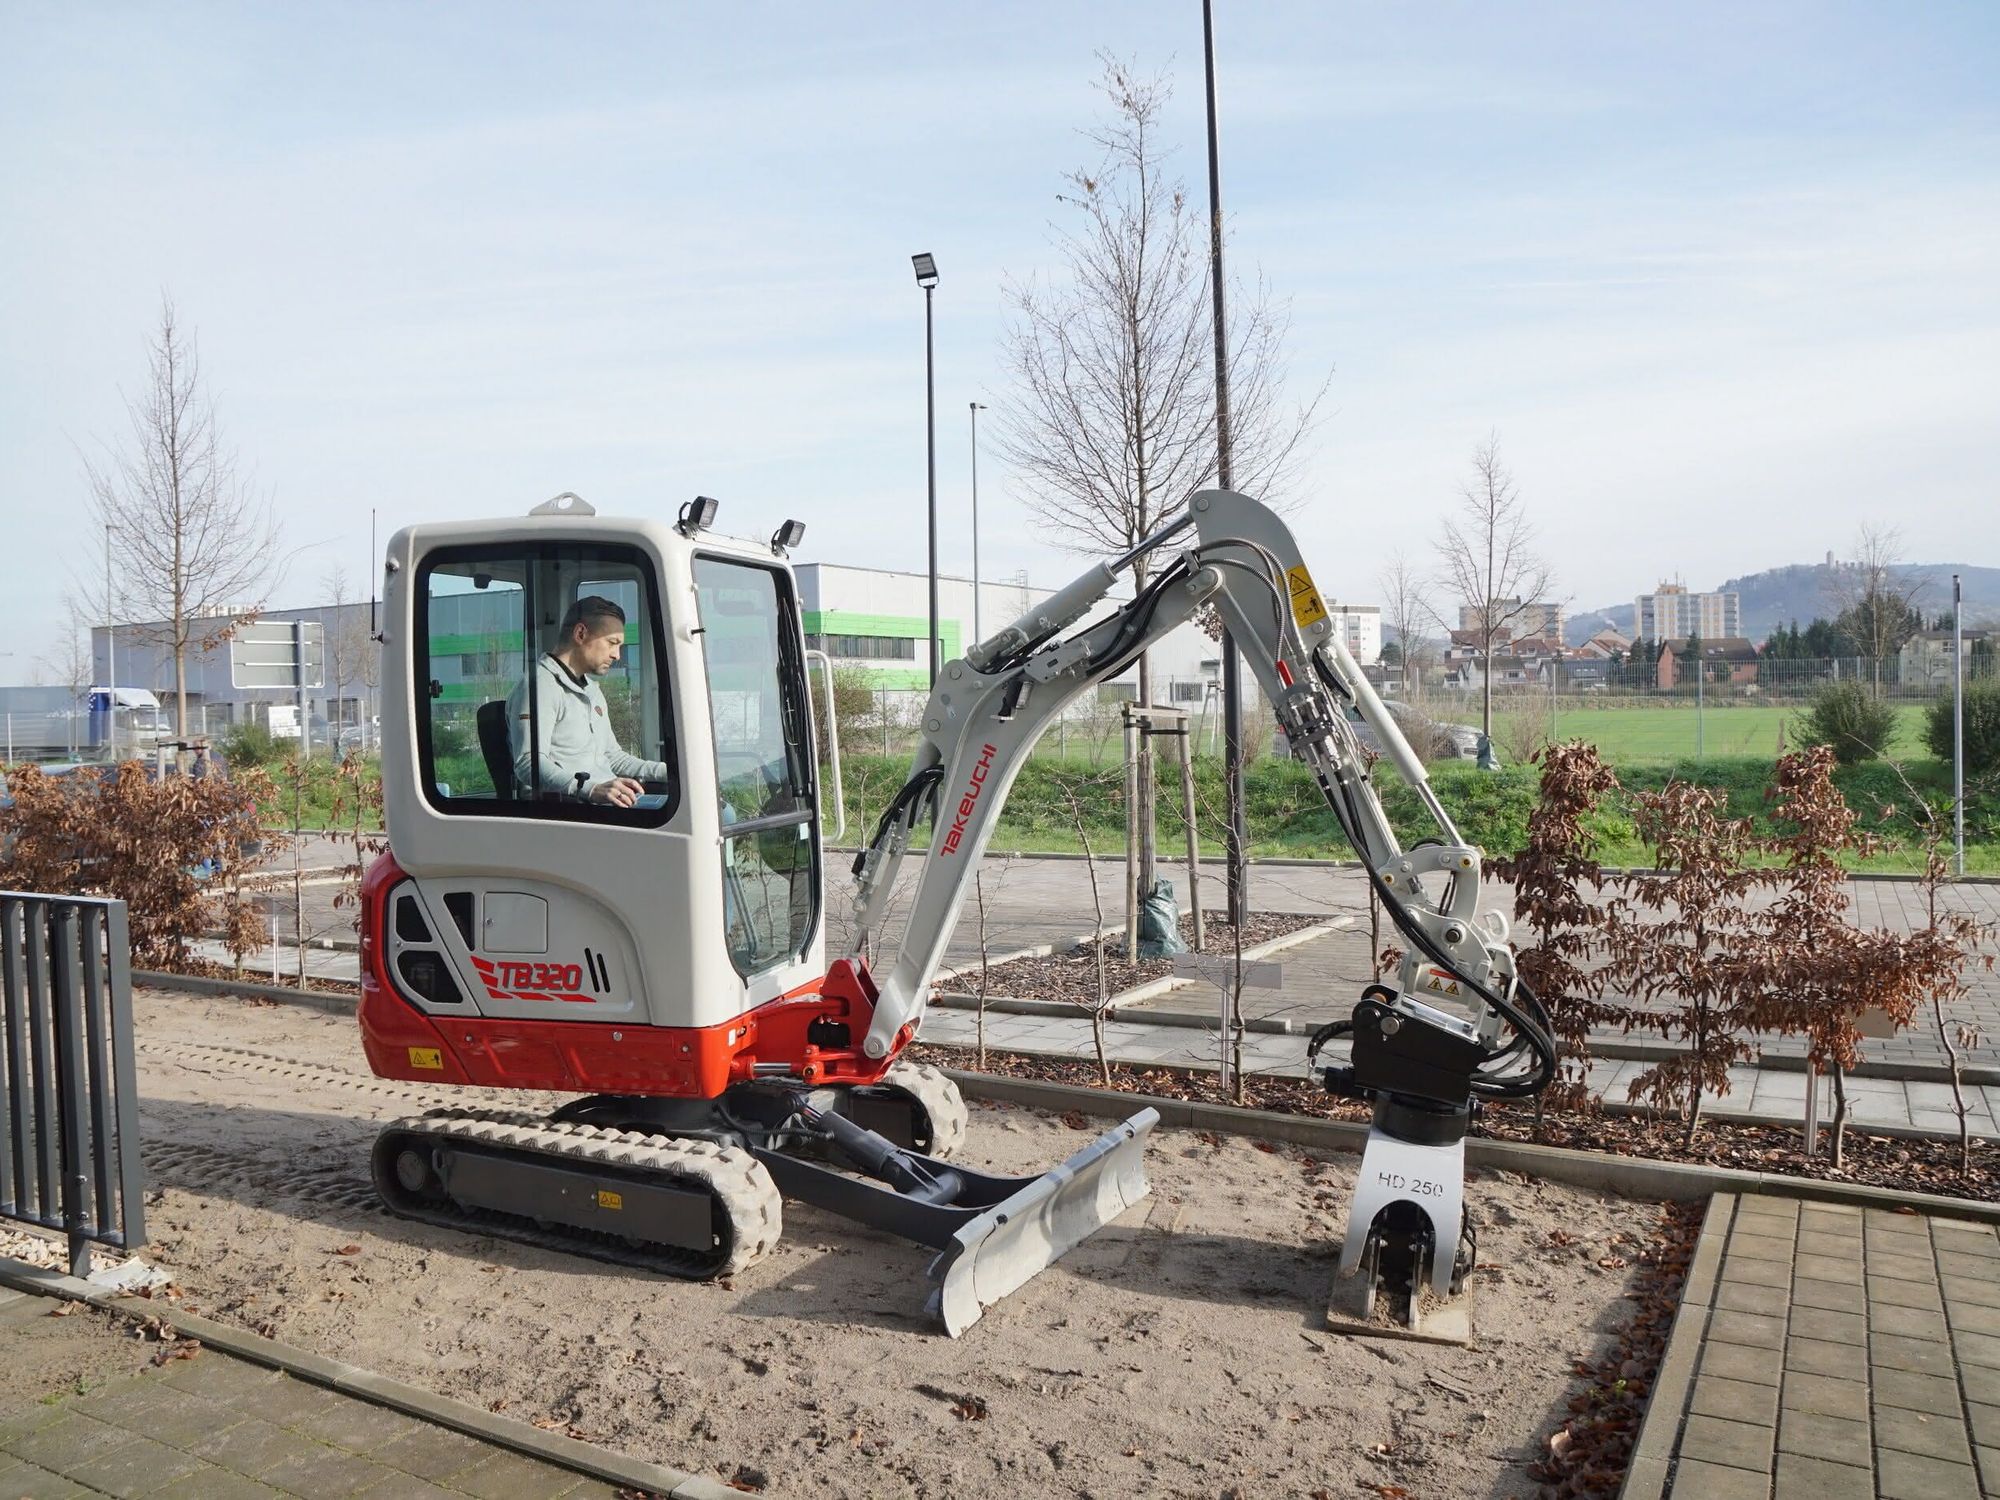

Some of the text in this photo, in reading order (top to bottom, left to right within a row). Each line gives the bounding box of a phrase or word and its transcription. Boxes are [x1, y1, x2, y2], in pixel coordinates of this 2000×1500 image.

[497, 961, 582, 991] TB320
[1378, 1172, 1443, 1198] HD 250
